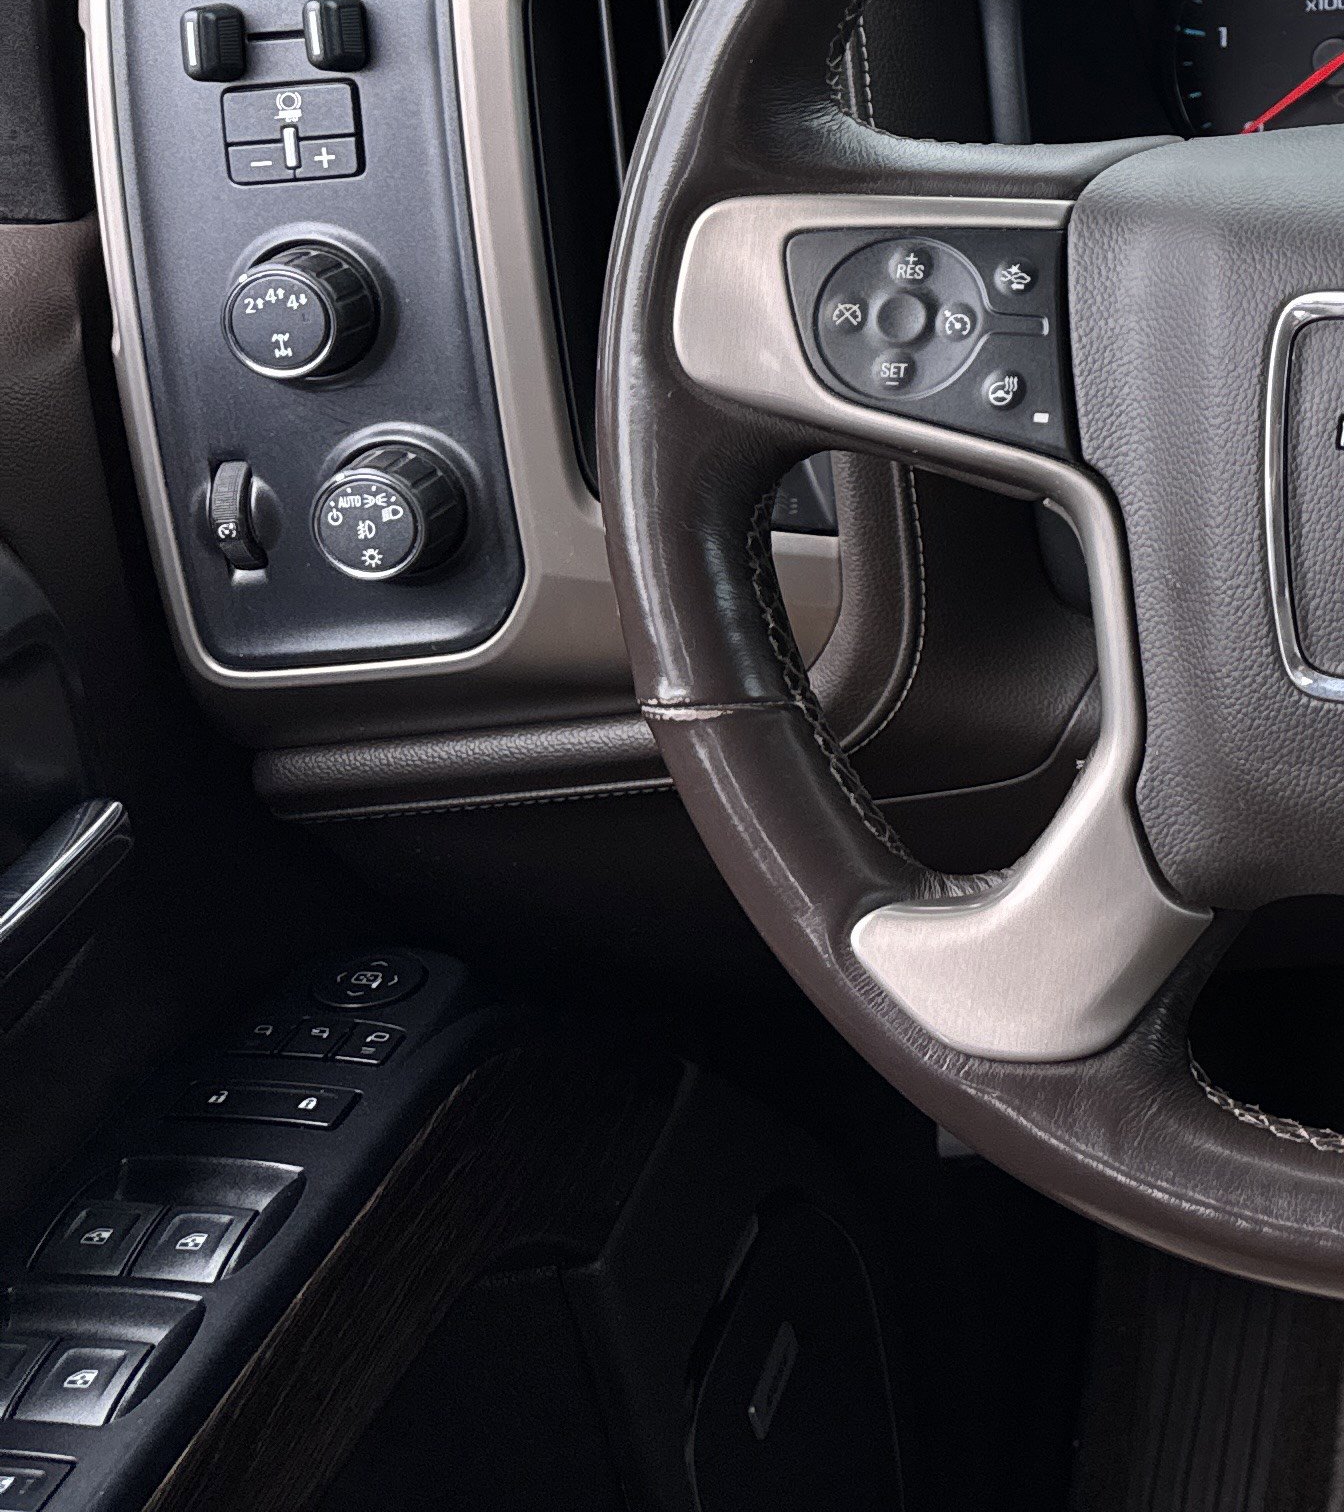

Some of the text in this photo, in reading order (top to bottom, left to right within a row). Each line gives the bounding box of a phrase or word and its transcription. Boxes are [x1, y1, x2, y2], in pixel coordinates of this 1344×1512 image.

[1217, 25, 1229, 49] 1
[896, 263, 925, 280] RES
[880, 362, 909, 378] SET
[338, 493, 362, 509] AUTO
